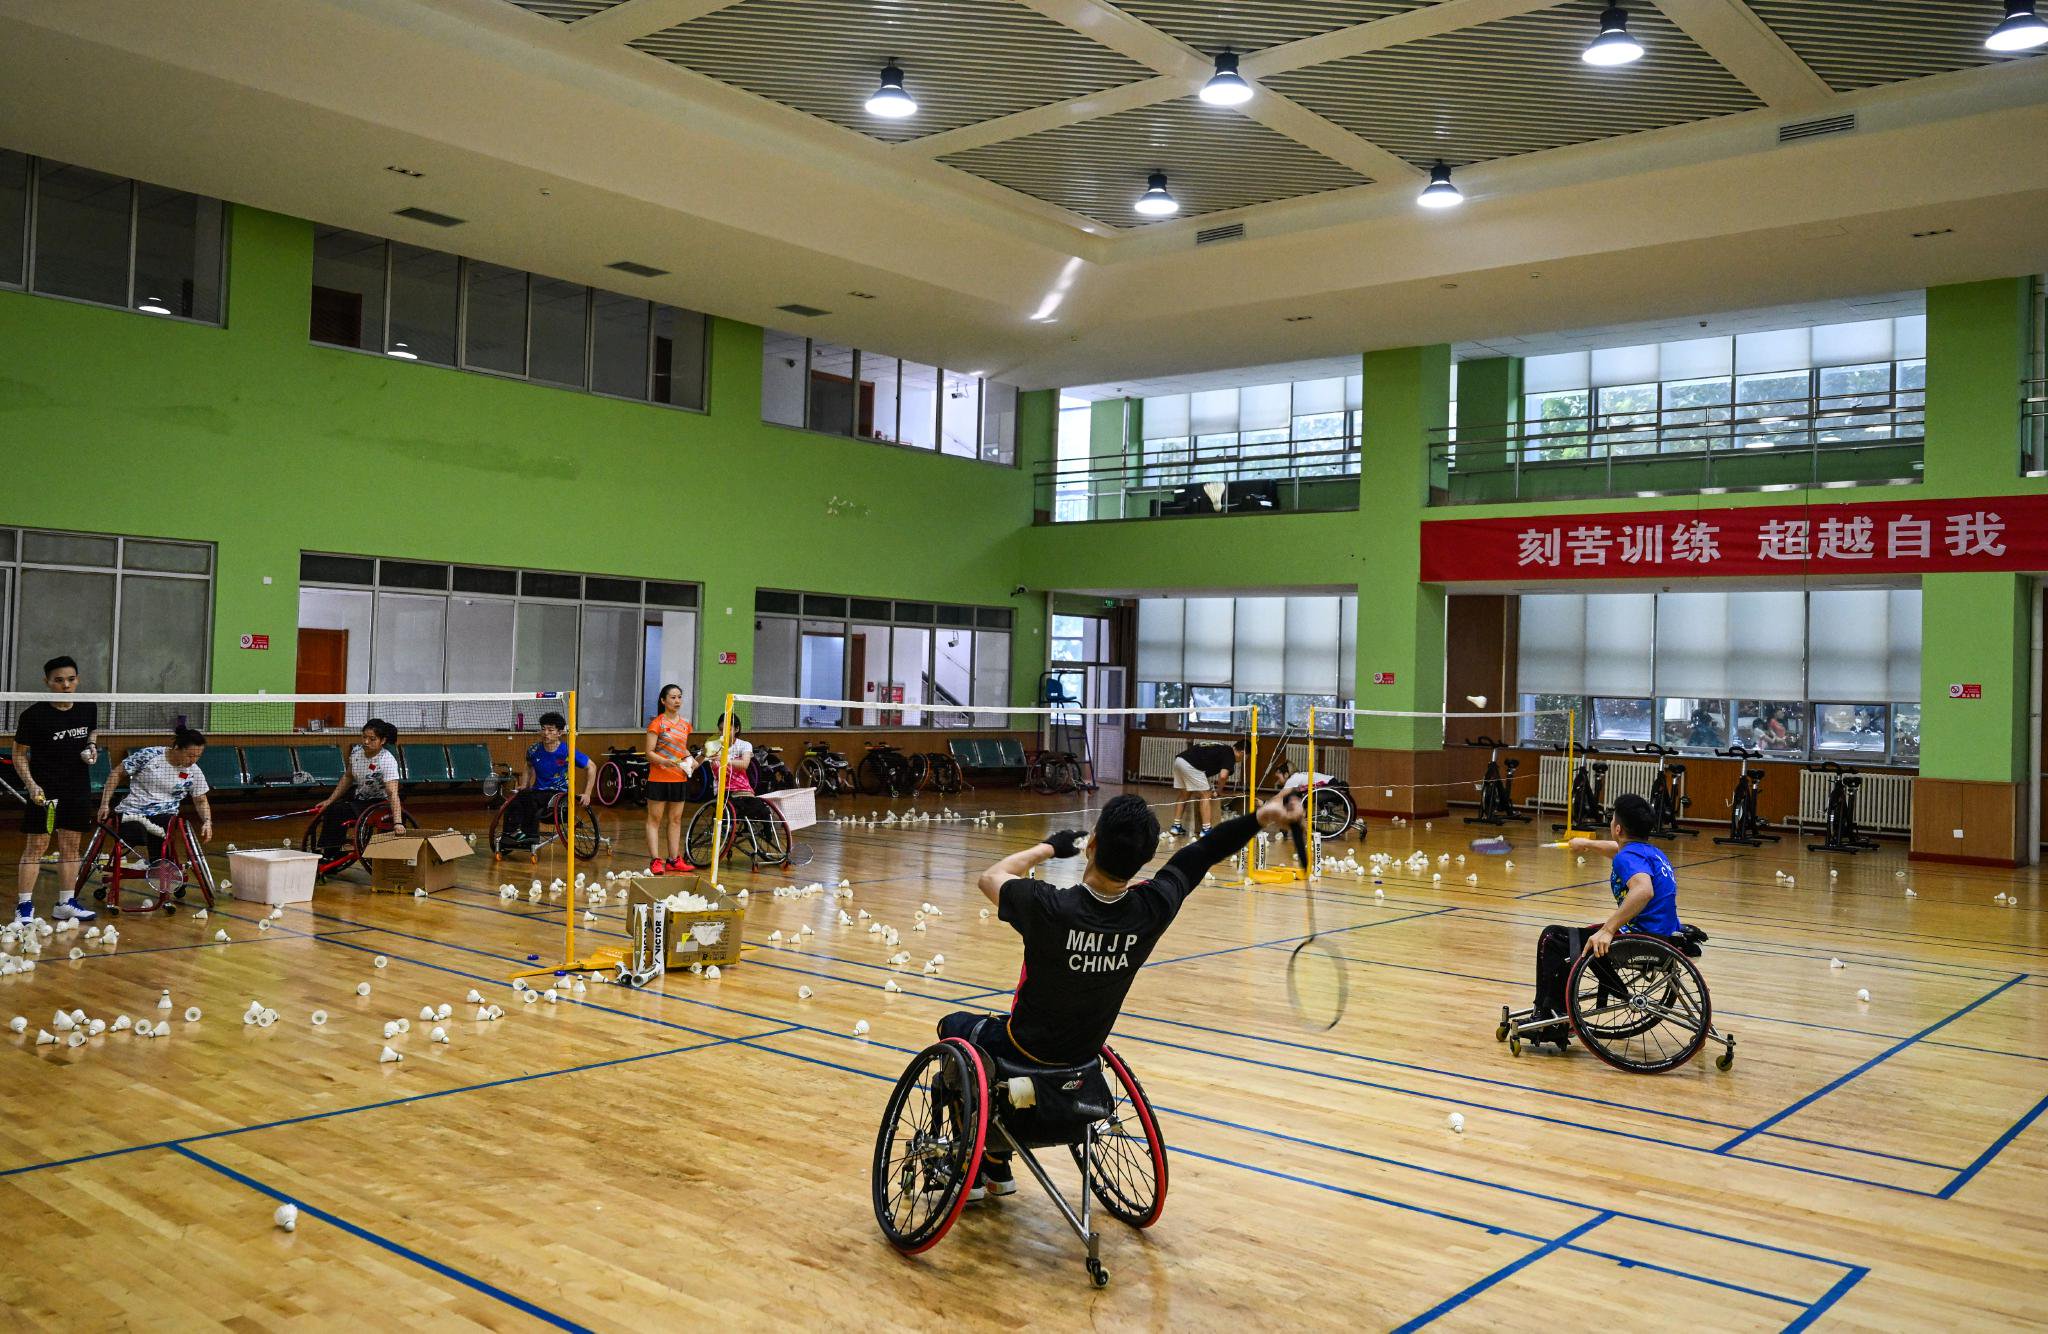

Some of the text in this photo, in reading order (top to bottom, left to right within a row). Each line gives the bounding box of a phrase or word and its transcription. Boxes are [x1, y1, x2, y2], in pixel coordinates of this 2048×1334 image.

[1517, 510, 2007, 567] 刻苦训练 超越自我
[1066, 929, 1137, 952] MAI J P
[1069, 953, 1128, 972] CHINA
